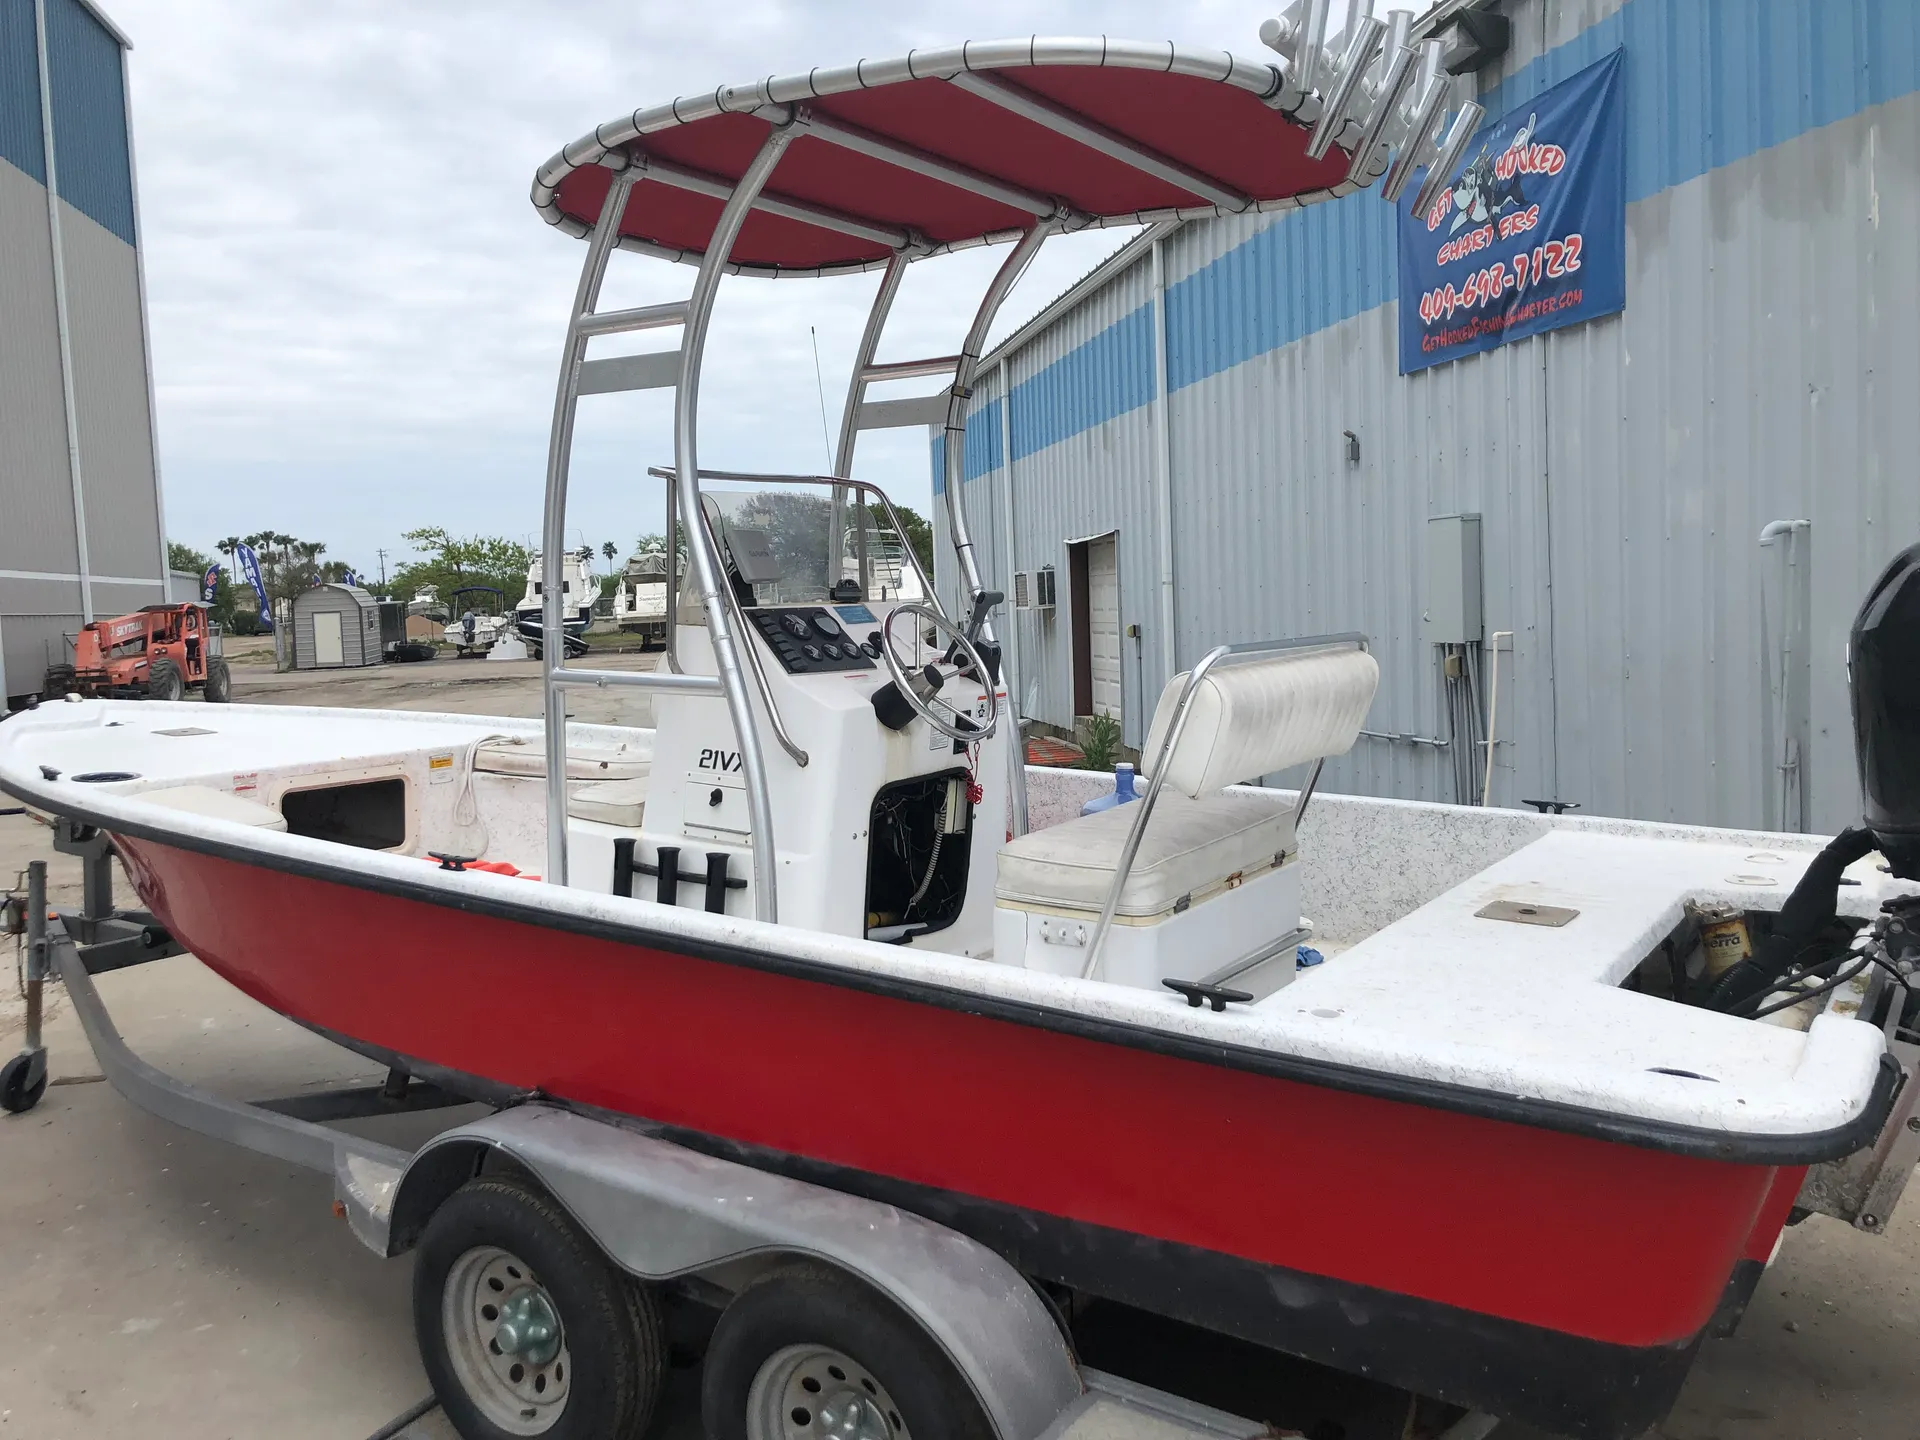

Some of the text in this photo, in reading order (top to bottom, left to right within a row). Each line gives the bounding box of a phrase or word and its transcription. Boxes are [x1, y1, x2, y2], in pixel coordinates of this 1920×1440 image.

[1427, 187, 1453, 232] GET
[1437, 204, 1540, 266] CHARTERS
[1419, 233, 1583, 326] 409-698-7122
[116, 620, 144, 637] SKYTRAK
[1710, 936, 1741, 948] erra
